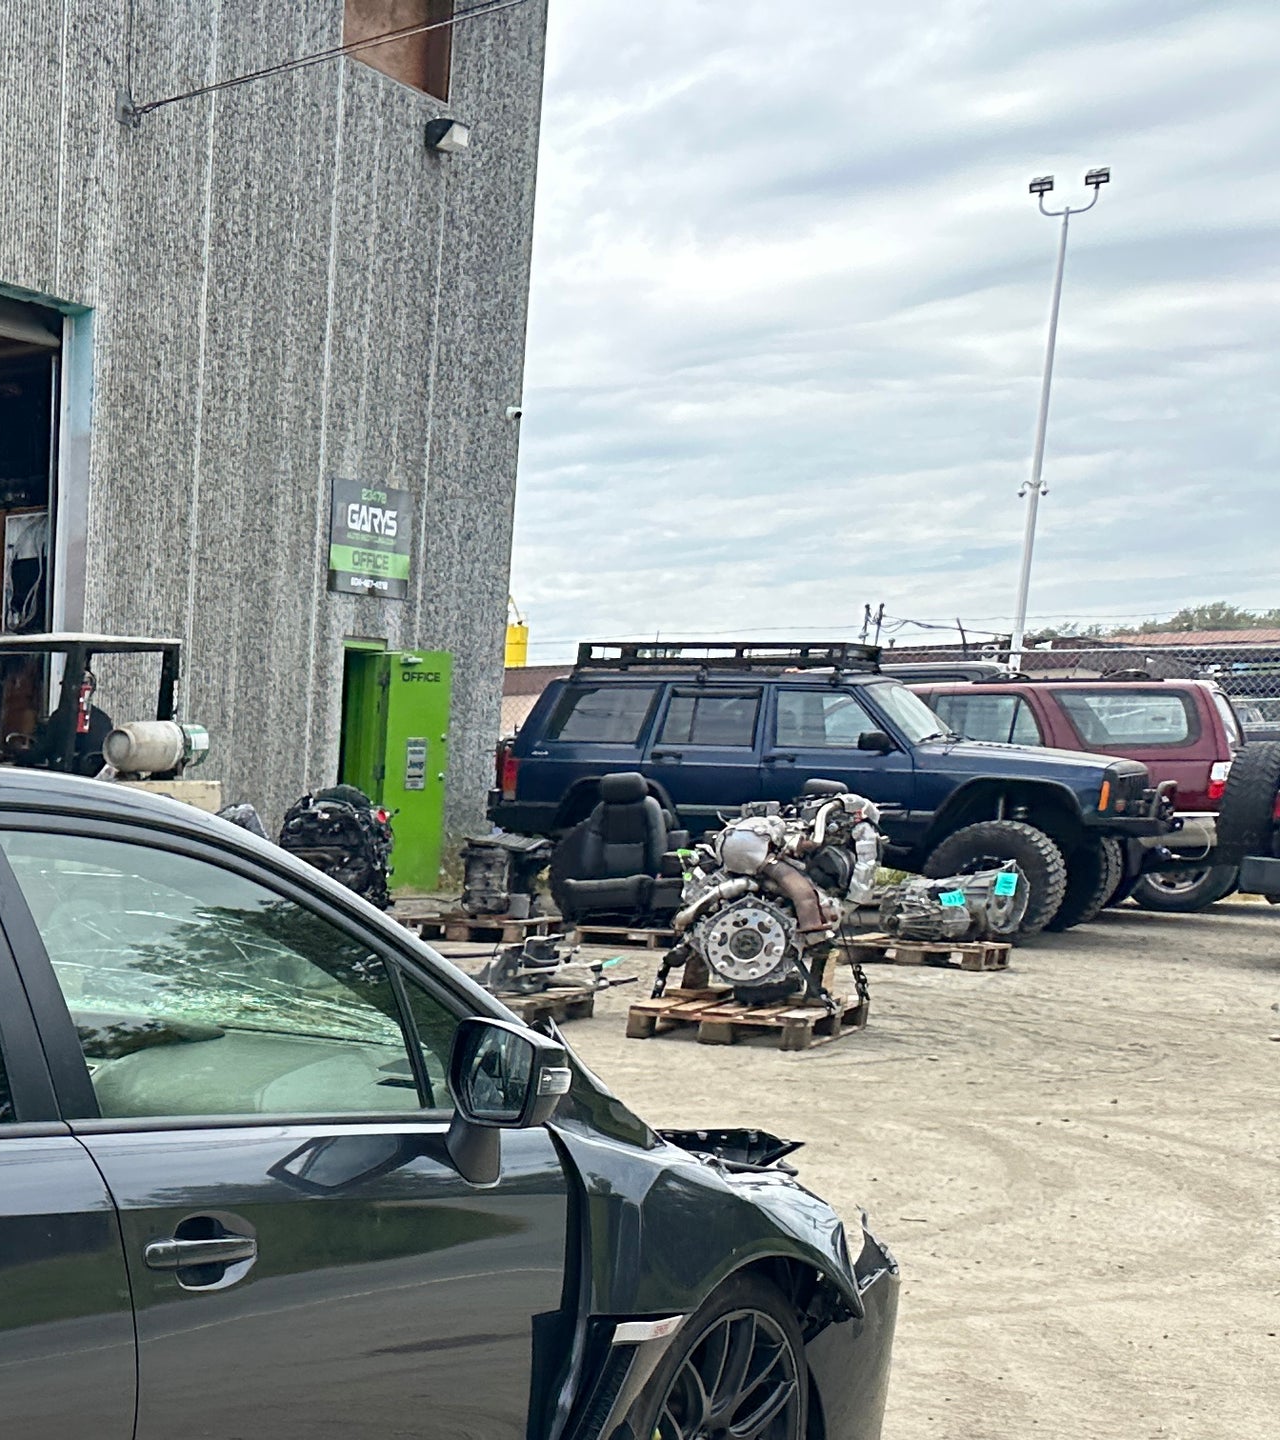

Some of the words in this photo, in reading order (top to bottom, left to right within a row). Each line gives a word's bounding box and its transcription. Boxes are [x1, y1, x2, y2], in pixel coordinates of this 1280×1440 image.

[347, 503, 398, 537] GARYS
[352, 550, 389, 570] OFFICE
[402, 671, 441, 683] OFFICE
